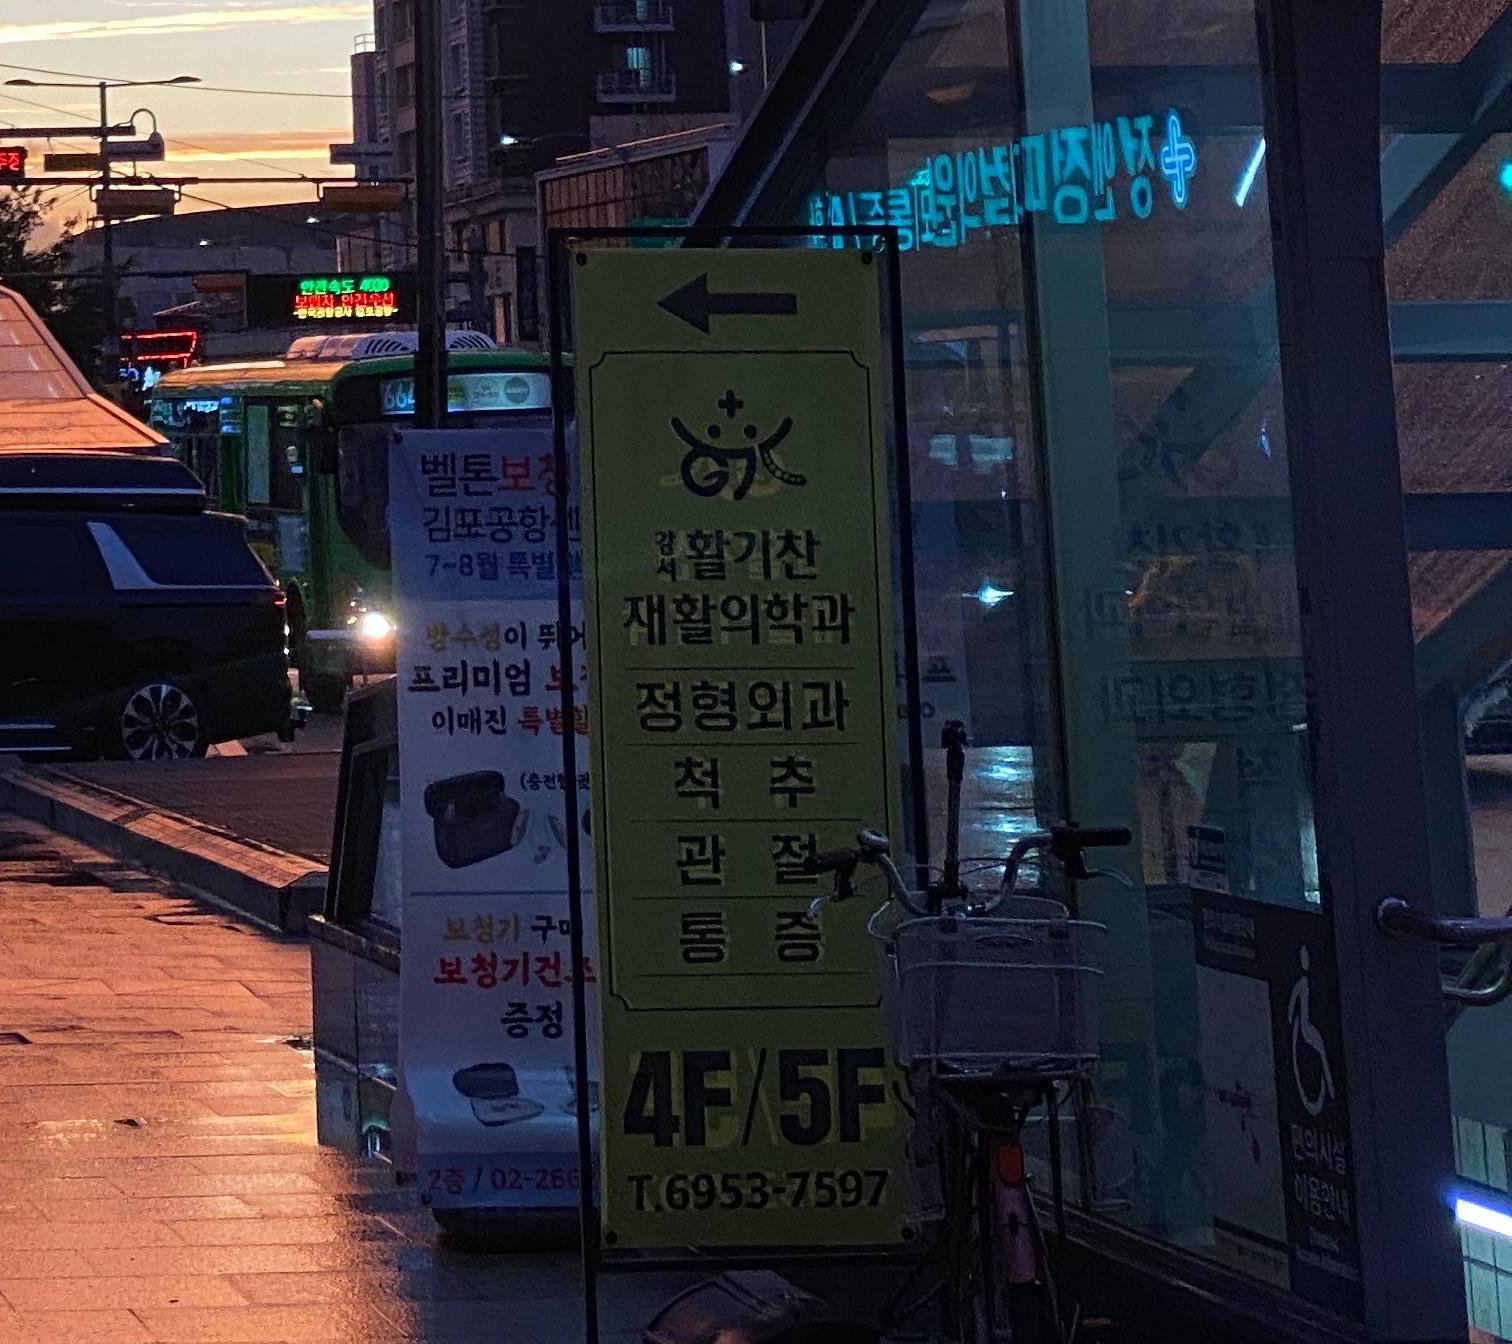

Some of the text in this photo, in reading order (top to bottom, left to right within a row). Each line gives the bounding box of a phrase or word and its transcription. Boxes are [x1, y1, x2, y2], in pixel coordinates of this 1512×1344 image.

[687, 529, 822, 582] 활기찬
[623, 593, 856, 647] 재활의학과
[408, 658, 531, 697] 프리미엄
[432, 705, 508, 736] 이매진
[636, 680, 851, 733] 정형외과
[443, 913, 521, 945] 보청기
[500, 1000, 564, 1040] 증정
[623, 1046, 886, 1148] 4F/5F
[628, 1169, 889, 1212] T.6953-7597
